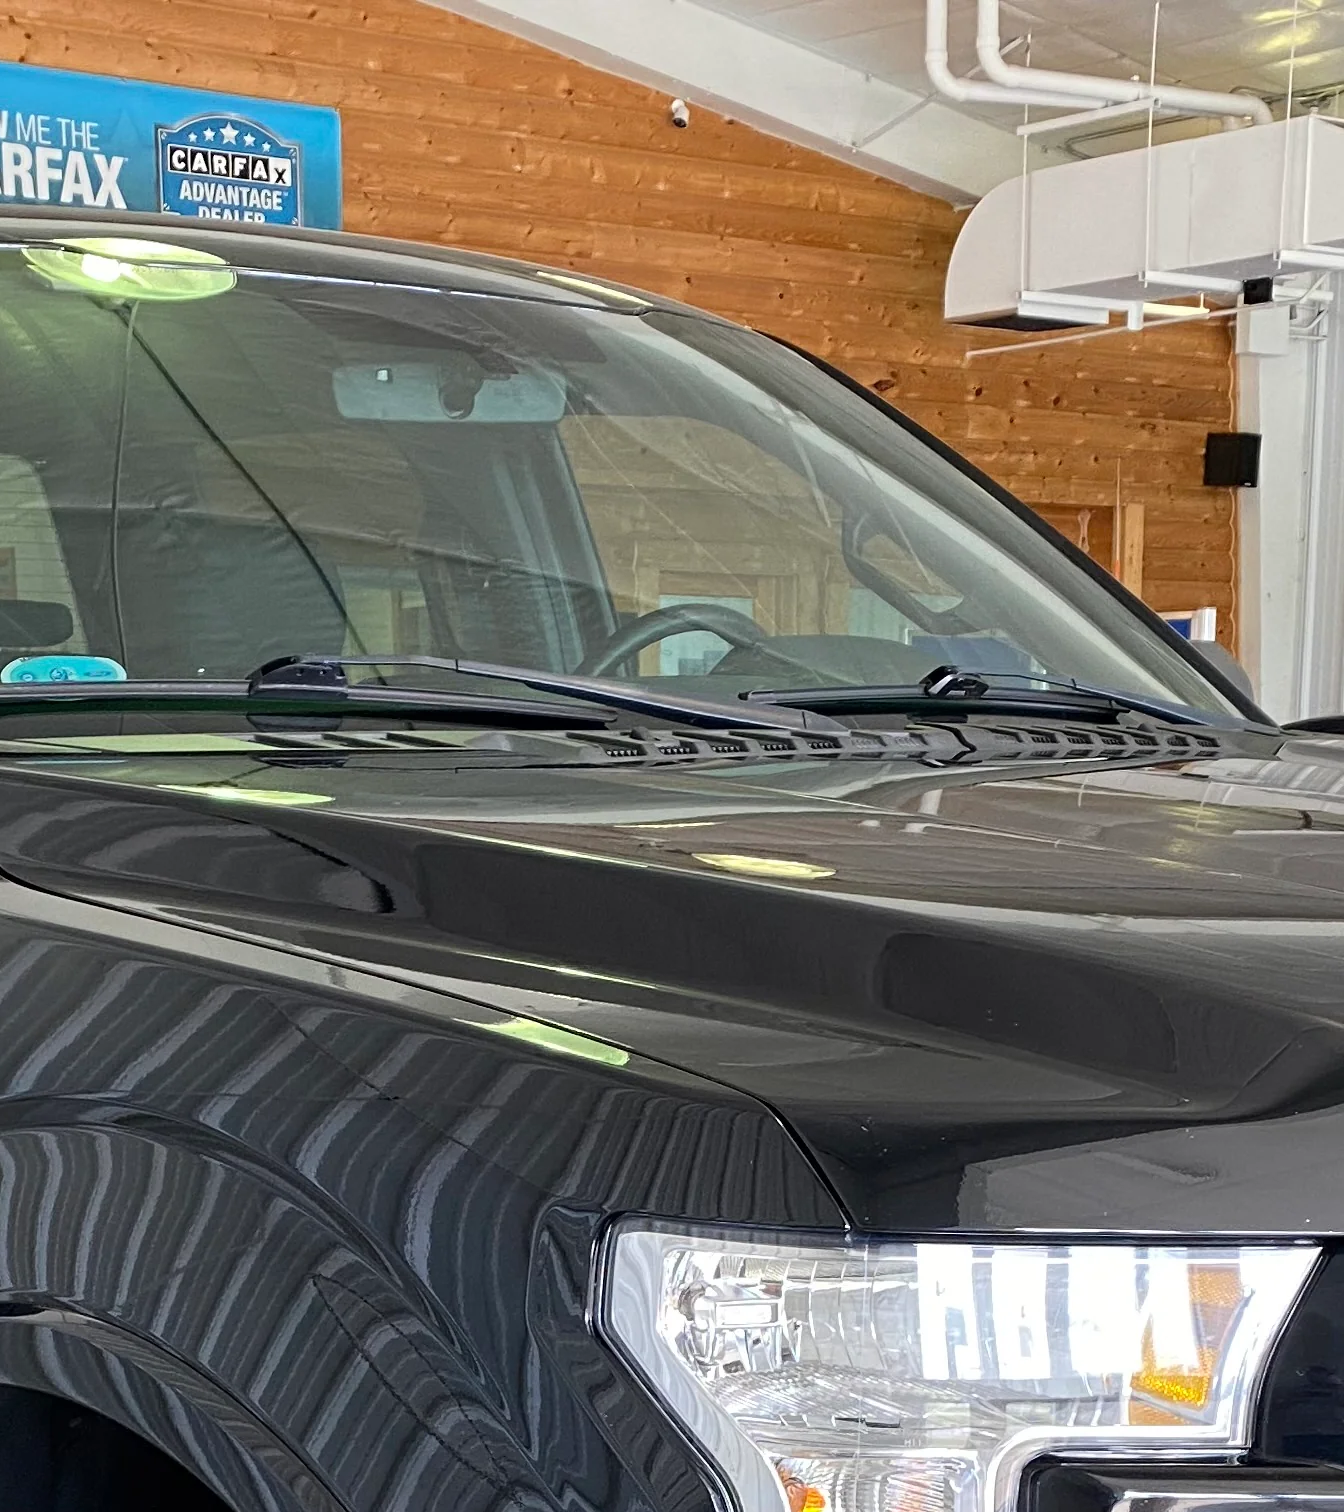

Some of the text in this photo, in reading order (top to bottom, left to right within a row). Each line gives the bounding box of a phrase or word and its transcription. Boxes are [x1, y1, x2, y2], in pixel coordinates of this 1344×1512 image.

[15, 111, 51, 145] ME
[56, 117, 100, 151] THE
[171, 149, 287, 185] CARFAX
[179, 179, 284, 211] ADVANTAGE
